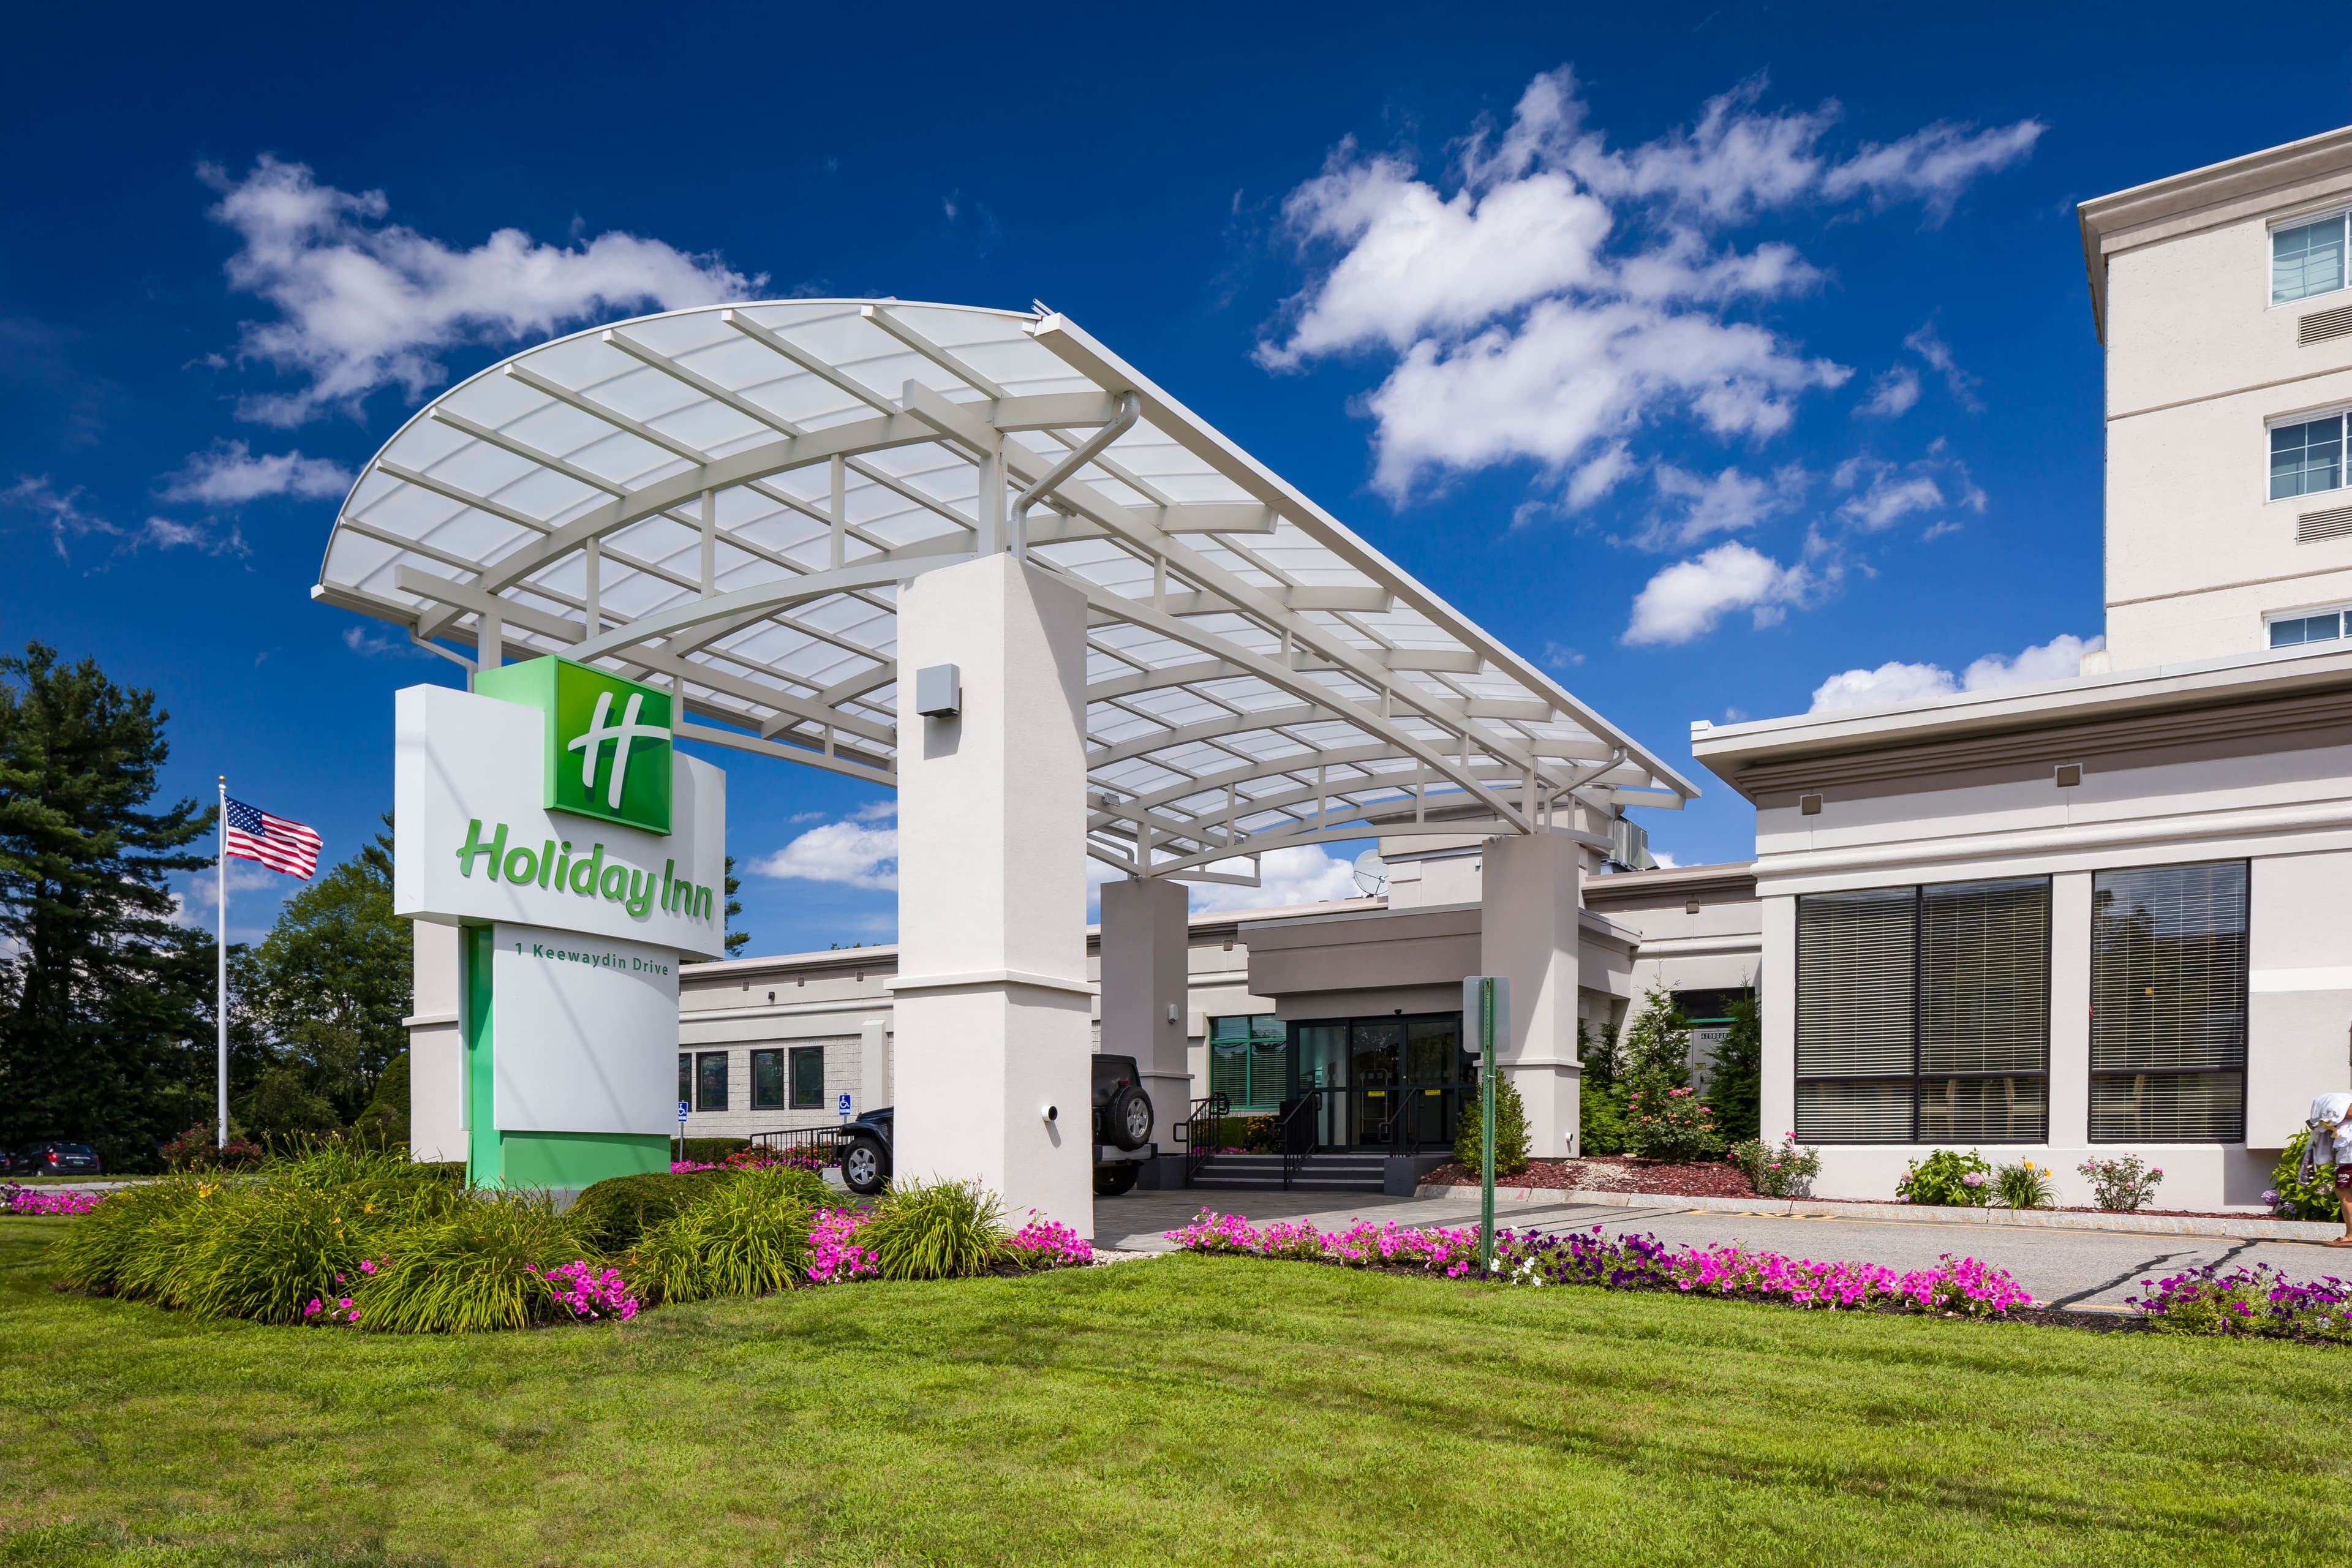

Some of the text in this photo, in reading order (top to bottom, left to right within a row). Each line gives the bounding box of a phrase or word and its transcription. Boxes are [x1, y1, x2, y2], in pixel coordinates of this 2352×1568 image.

[567, 692, 671, 809] H
[456, 819, 712, 920] Holiday Inn
[515, 942, 668, 976] 1 Keewaydin Drive
